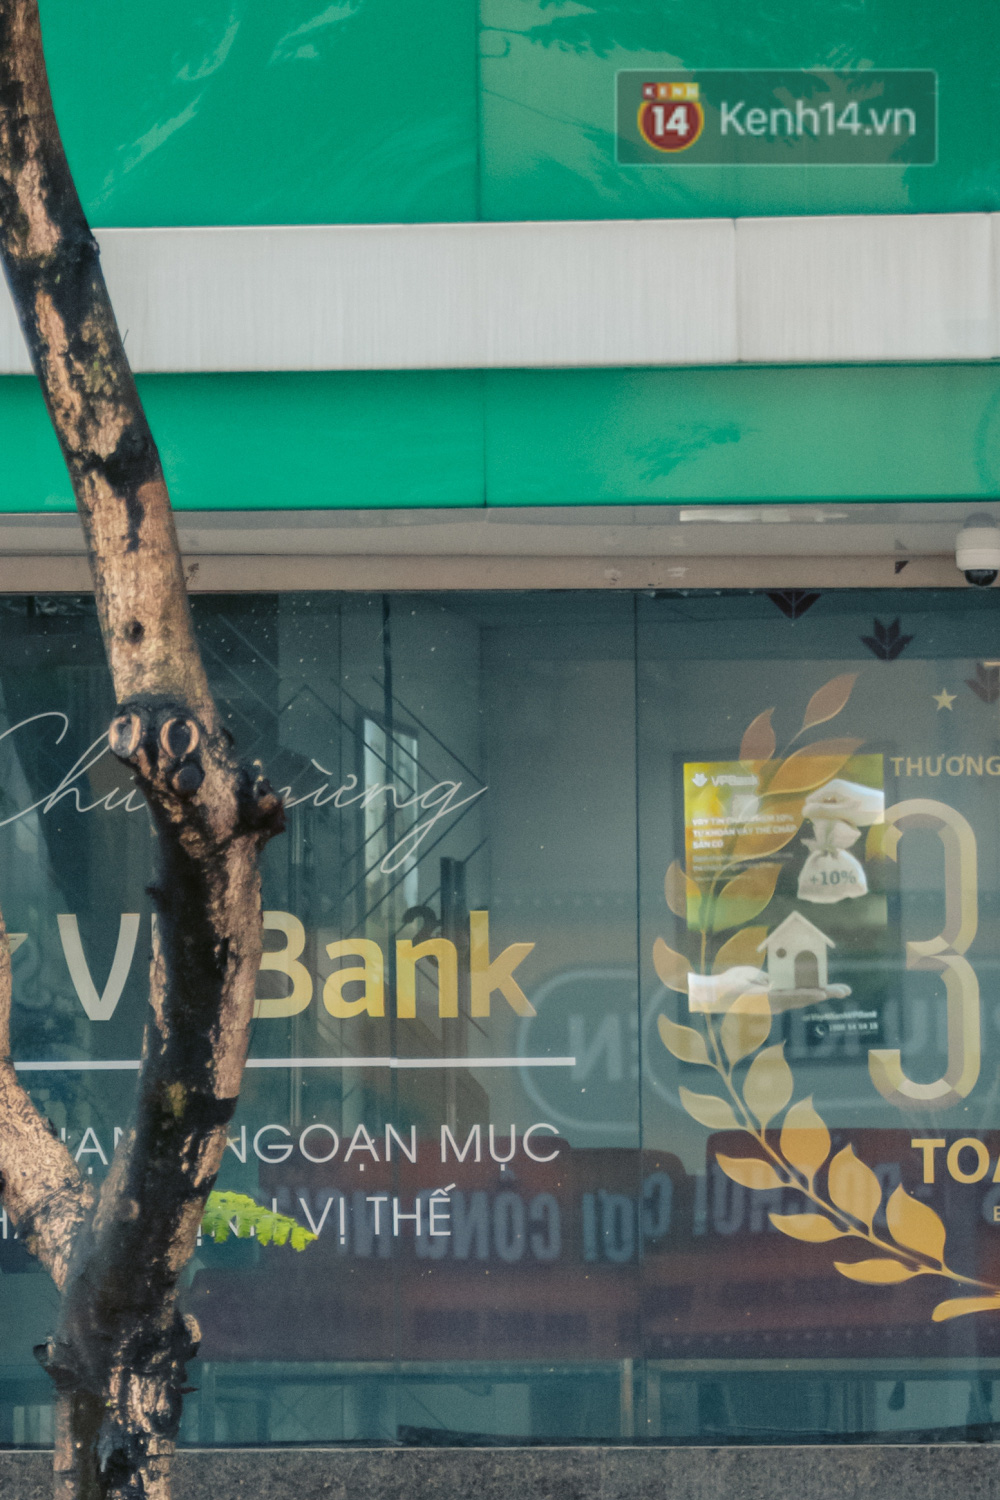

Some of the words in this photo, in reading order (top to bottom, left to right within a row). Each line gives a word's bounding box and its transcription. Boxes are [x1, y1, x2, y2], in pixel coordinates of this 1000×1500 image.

[889, 753, 1000, 777] THƯƠNG
[810, 870, 857, 886] +10%
[57, 910, 537, 1021] VBank
[441, 1121, 561, 1172] MỤC
[910, 1137, 1000, 1184] TO
[299, 1197, 345, 1244] VỊ
[366, 1183, 456, 1236] THẾ
